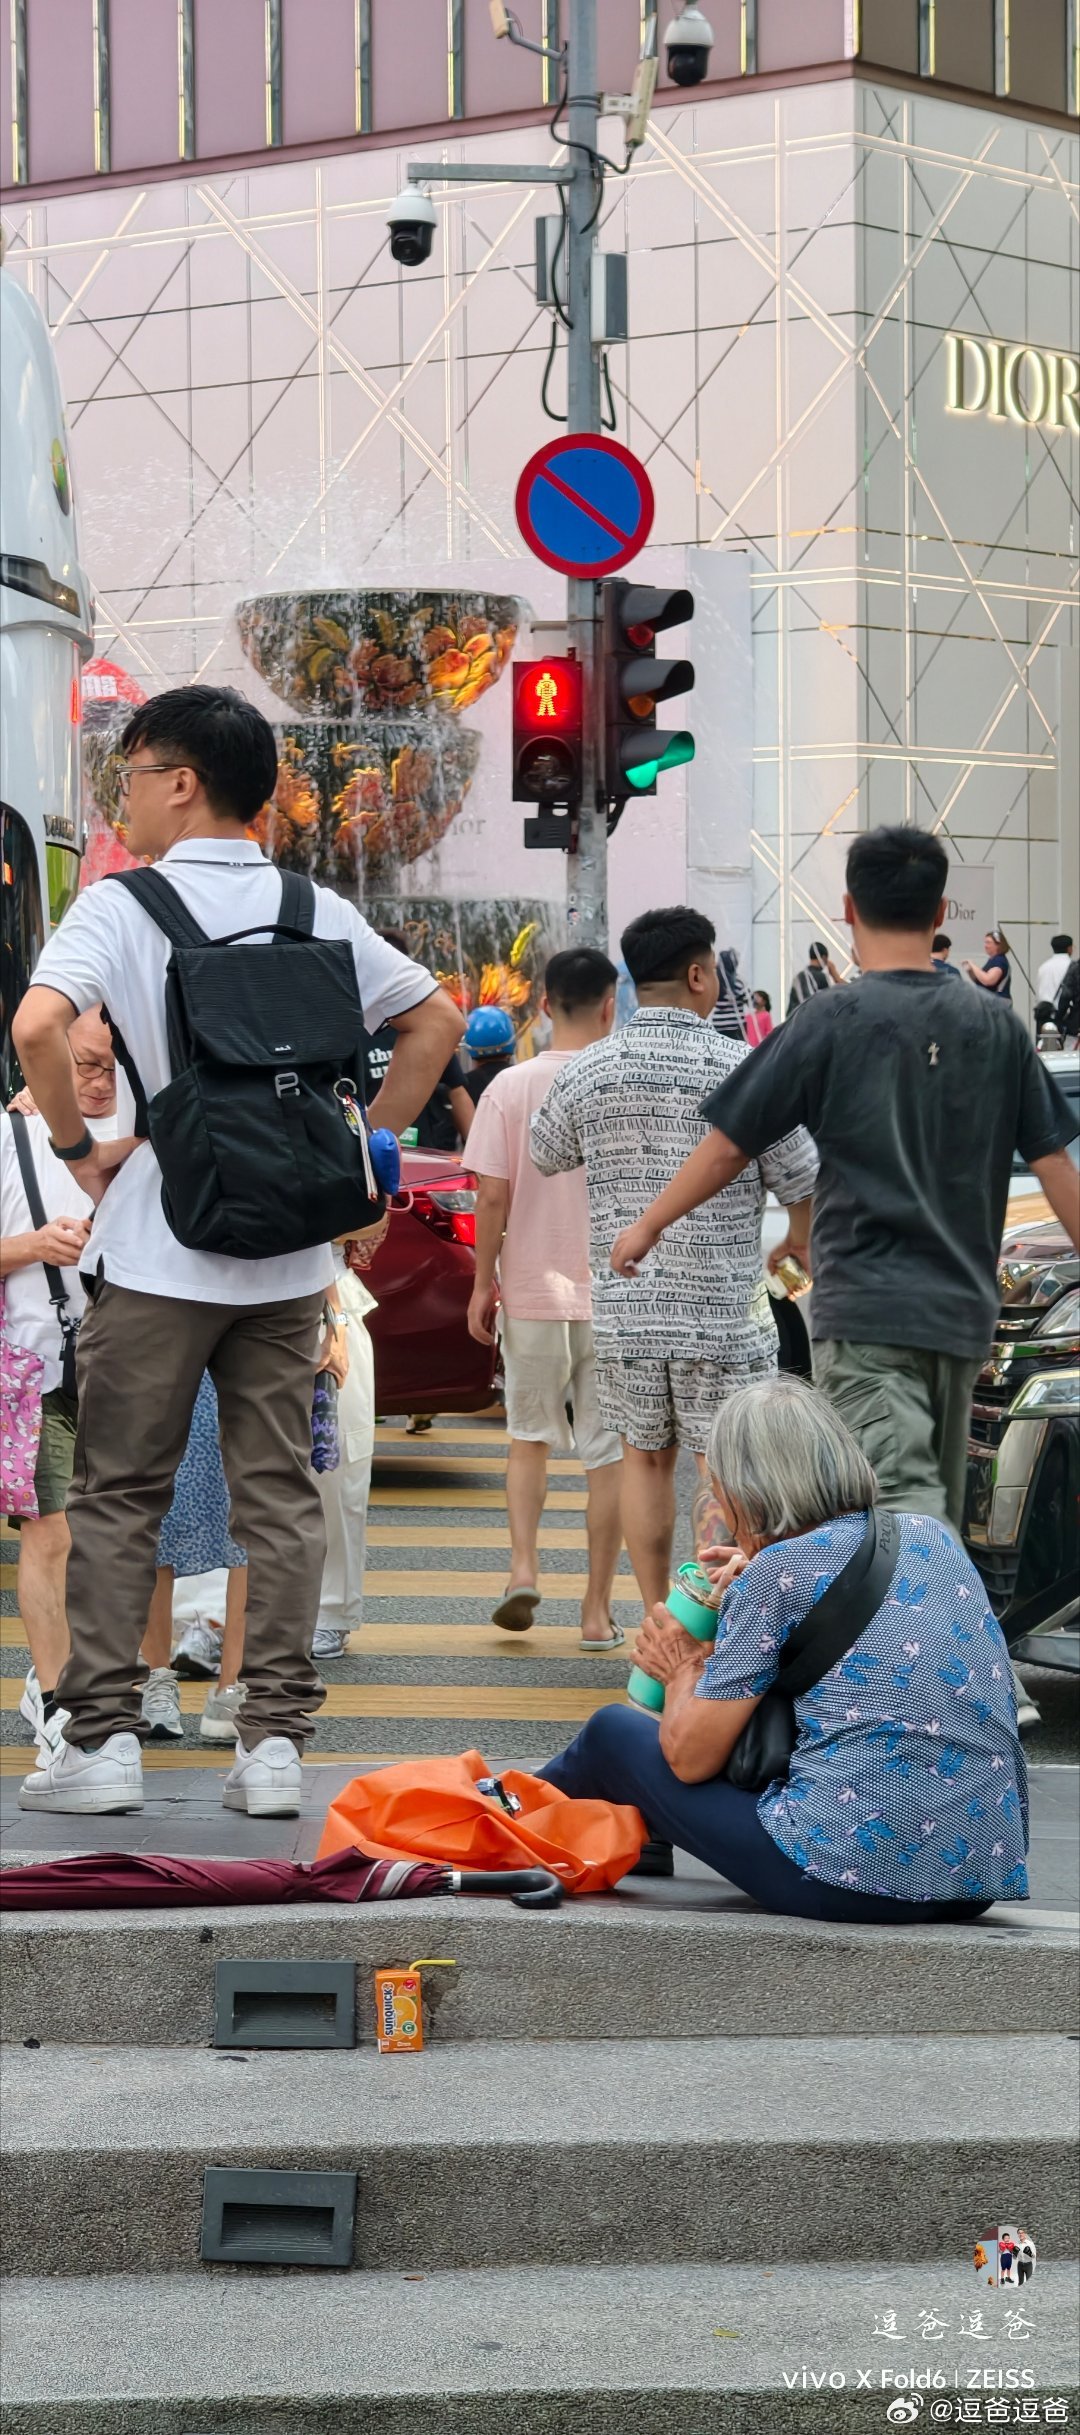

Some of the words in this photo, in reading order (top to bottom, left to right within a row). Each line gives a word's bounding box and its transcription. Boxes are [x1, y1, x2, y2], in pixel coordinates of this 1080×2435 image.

[945, 334, 1080, 436] DIOR
[452, 819, 486, 836] ior
[947, 899, 976, 921] Dior
[648, 1051, 699, 1065] Alexander
[703, 1057, 731, 1071] Wang
[641, 1145, 669, 1158] Wang
[681, 1271, 728, 1283] Alexander
